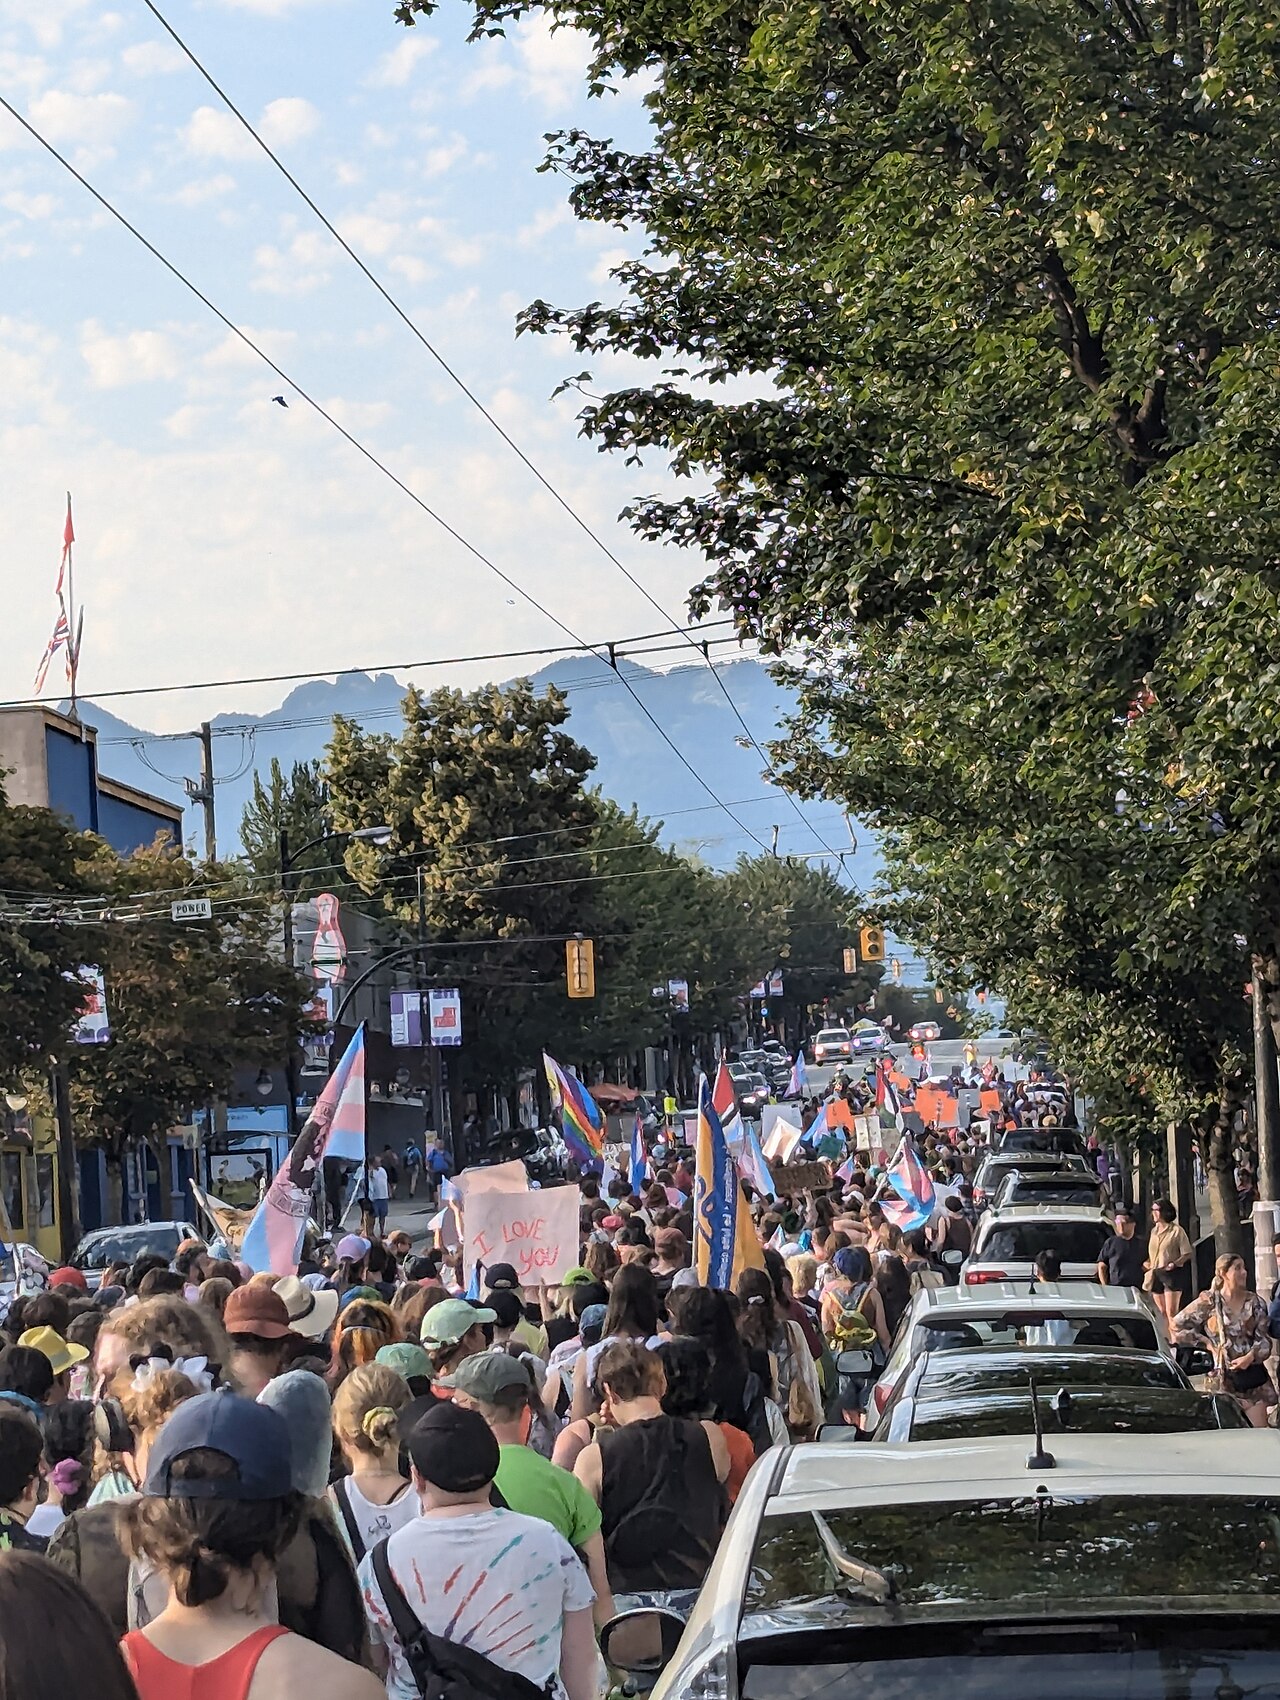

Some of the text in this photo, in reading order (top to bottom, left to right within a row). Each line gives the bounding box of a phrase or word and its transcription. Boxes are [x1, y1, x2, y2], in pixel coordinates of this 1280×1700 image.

[176, 902, 207, 914] POWER
[473, 1218, 545, 1257] I LOVE
